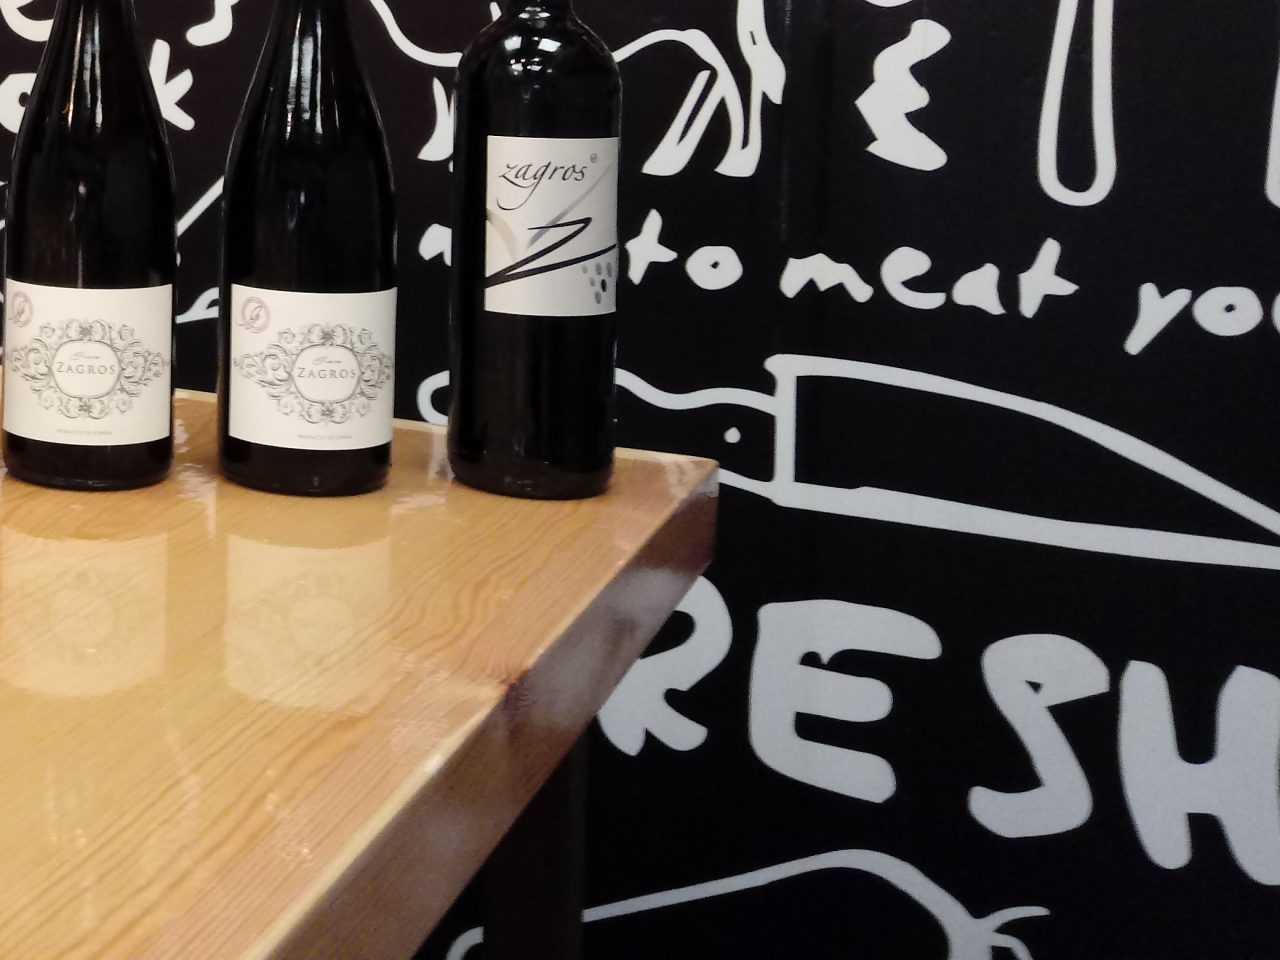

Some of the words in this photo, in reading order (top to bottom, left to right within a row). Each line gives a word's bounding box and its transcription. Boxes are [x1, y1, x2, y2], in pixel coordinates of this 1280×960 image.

[496, 161, 588, 211] zagros
[627, 208, 744, 290] to
[778, 237, 1080, 318] meat
[1123, 281, 1280, 356] yo
[56, 361, 116, 375] ZAGROS
[298, 367, 357, 380] ZAGROS
[599, 574, 1280, 887] RESH
